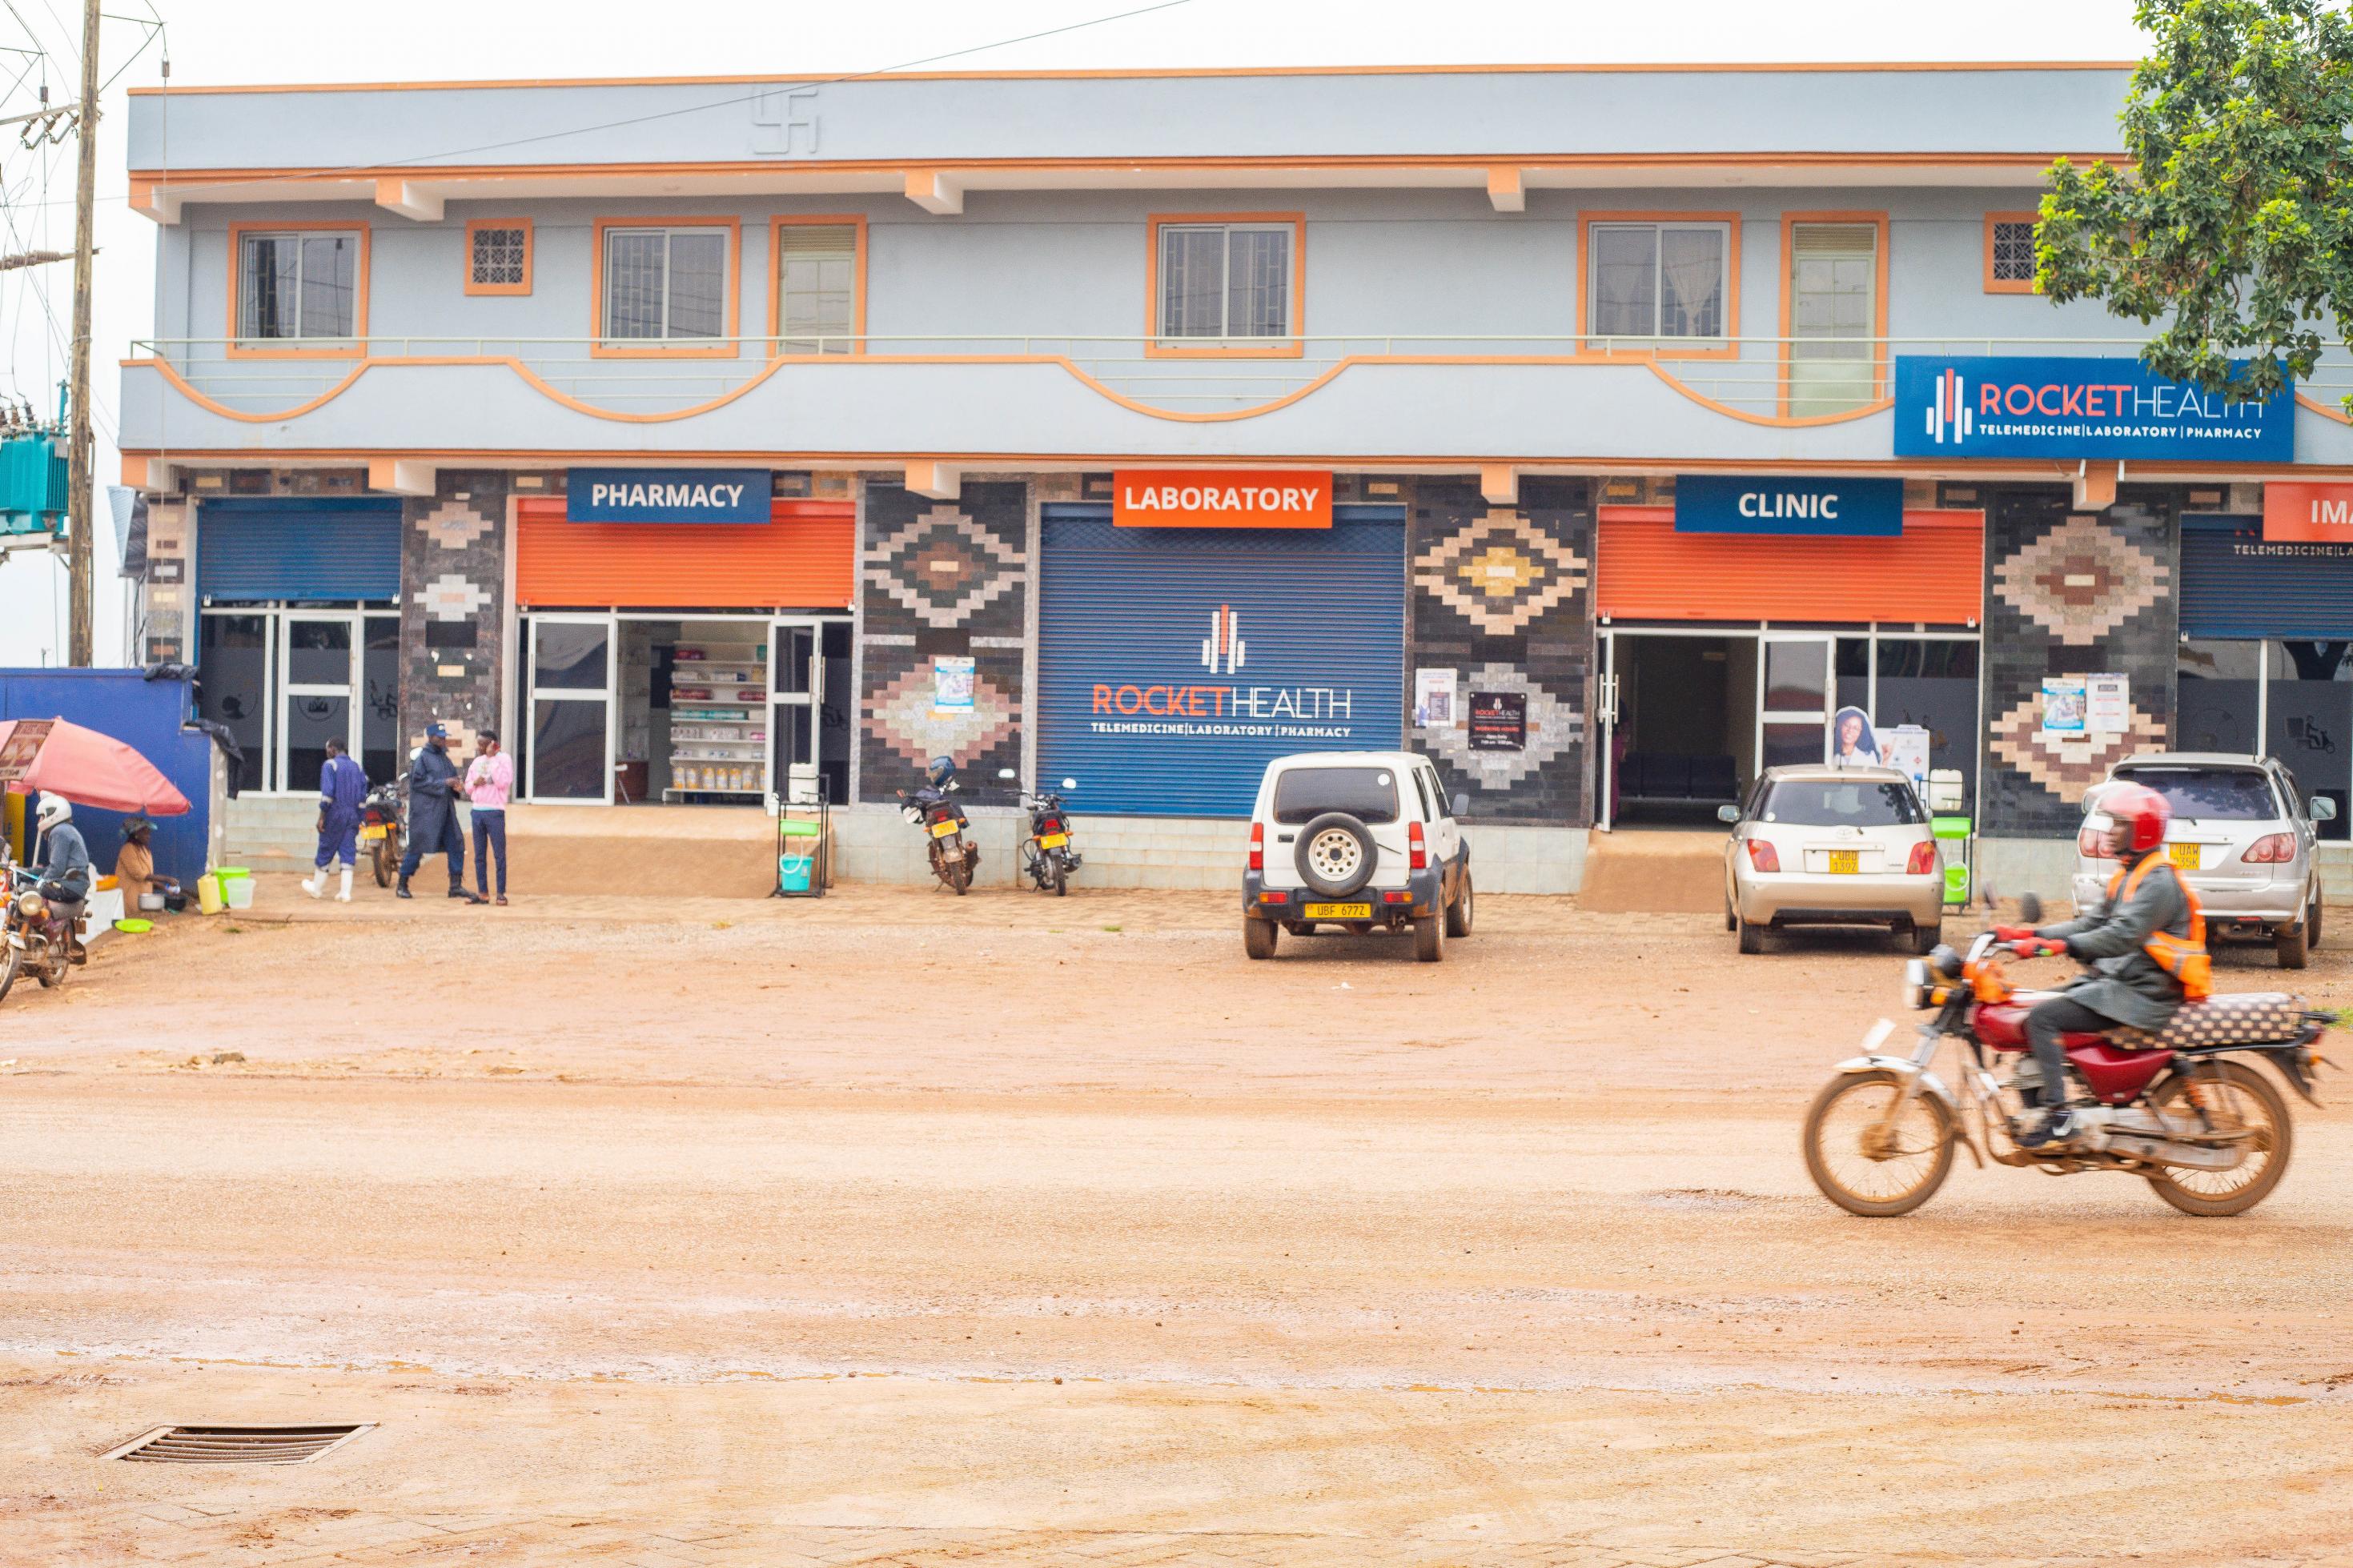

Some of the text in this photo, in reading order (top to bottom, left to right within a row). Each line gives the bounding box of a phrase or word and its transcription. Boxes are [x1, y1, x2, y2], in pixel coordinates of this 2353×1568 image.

[2186, 427, 2262, 439] PHARMACY
[592, 483, 744, 507] PHARMACY
[1125, 487, 1319, 511] LABORATORY
[1738, 492, 1838, 519] CLINIC
[2311, 499, 2353, 524] IM
[1281, 726, 1351, 737] PHARMACY
[2178, 844, 2198, 856] UAW
[1317, 905, 1365, 916] UBF 677Z
